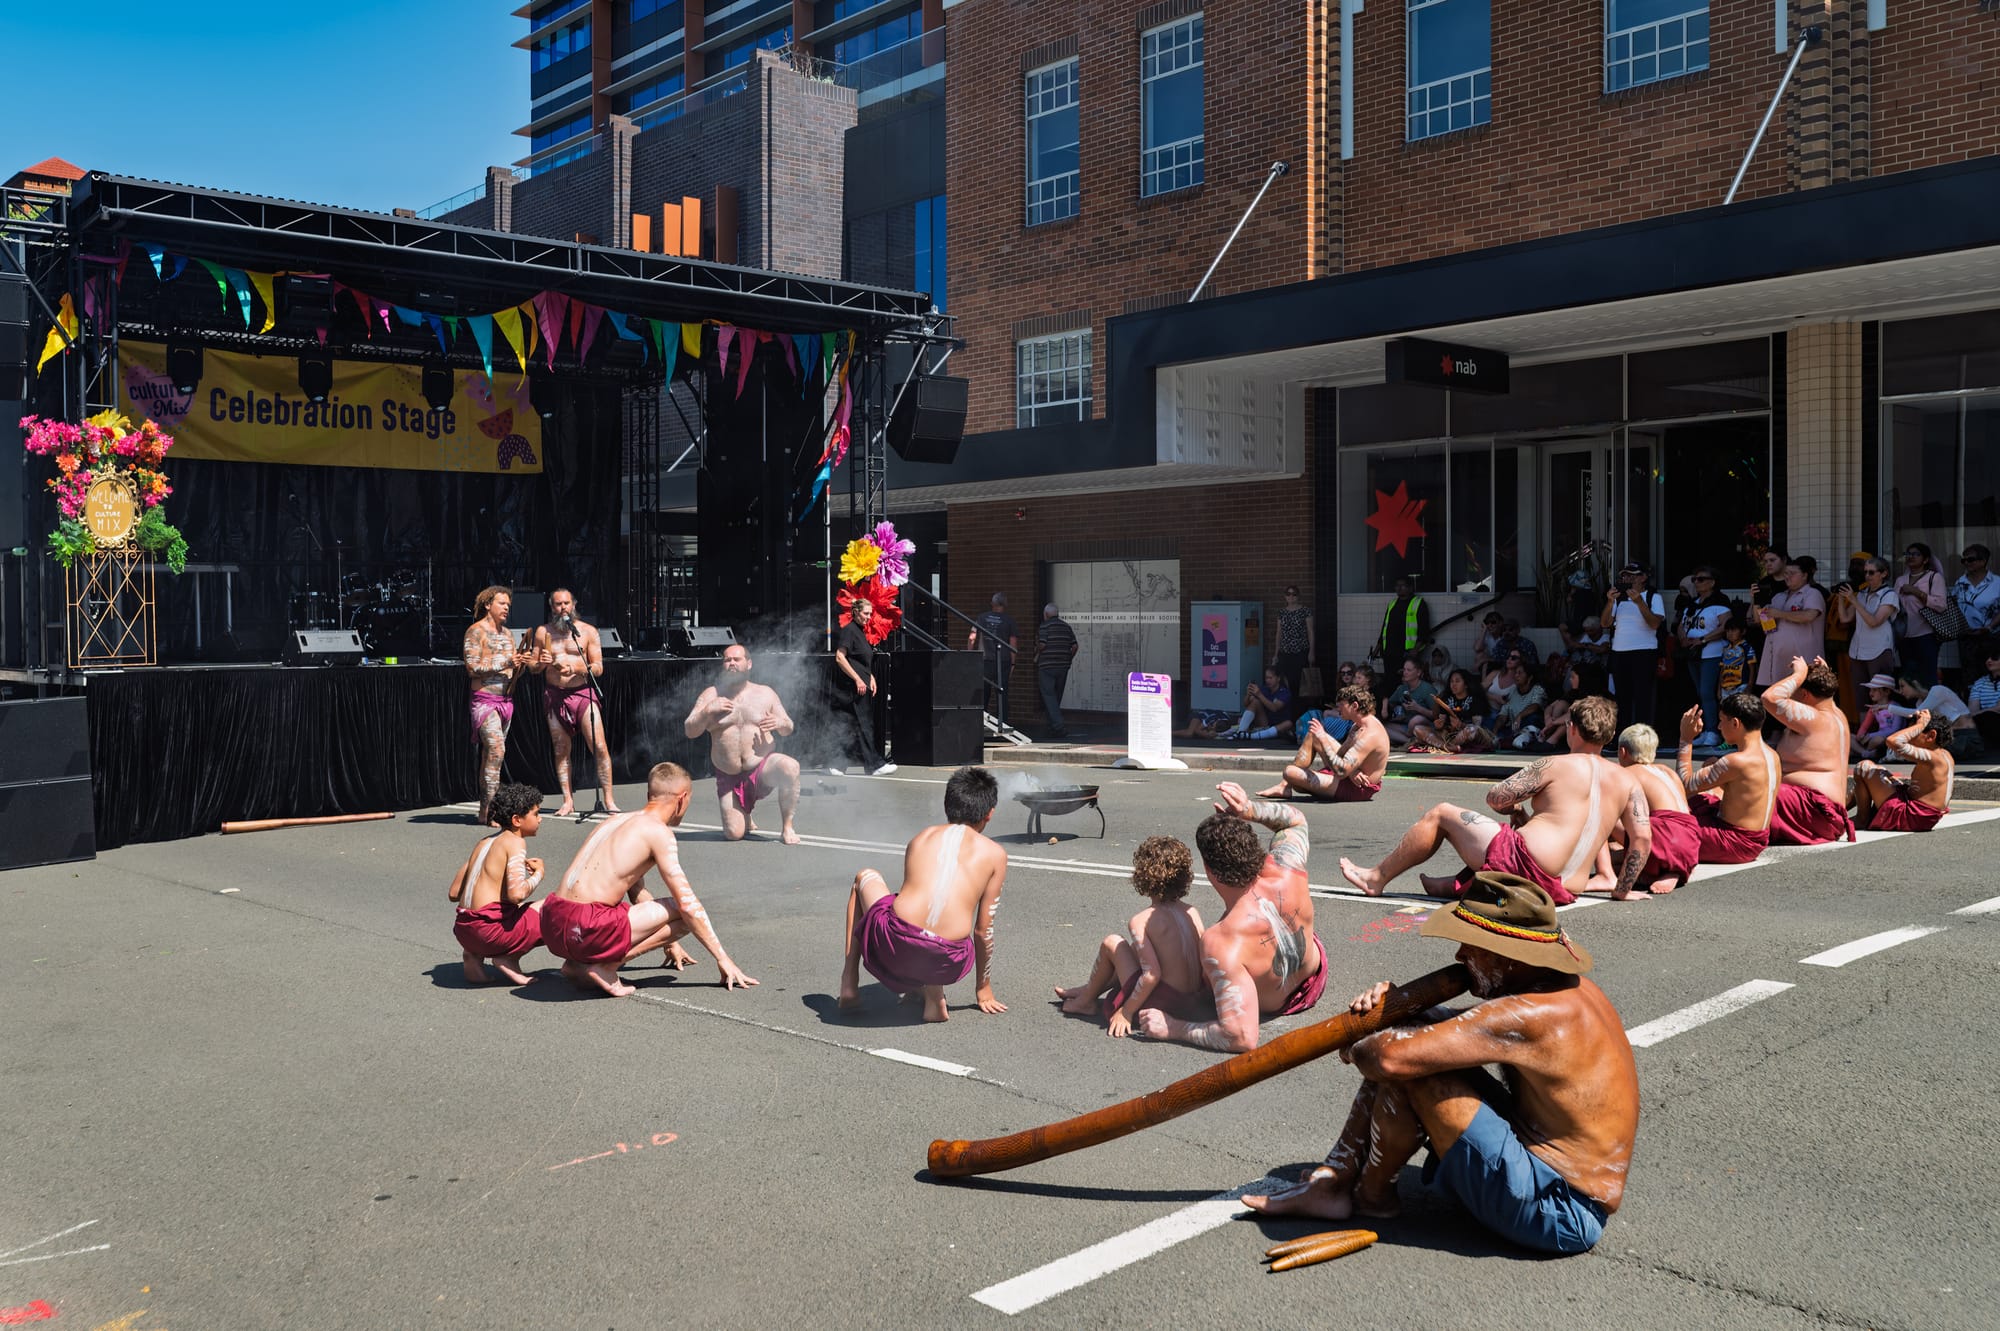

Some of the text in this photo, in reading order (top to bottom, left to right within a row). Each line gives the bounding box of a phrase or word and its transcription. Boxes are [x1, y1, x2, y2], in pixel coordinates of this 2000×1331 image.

[1455, 359, 1477, 376] nab
[129, 381, 184, 400] cultur
[153, 394, 193, 417] Mix
[209, 387, 456, 440] Celebration Stage
[91, 489, 130, 504] WELCOME
[97, 519, 121, 531] MIX
